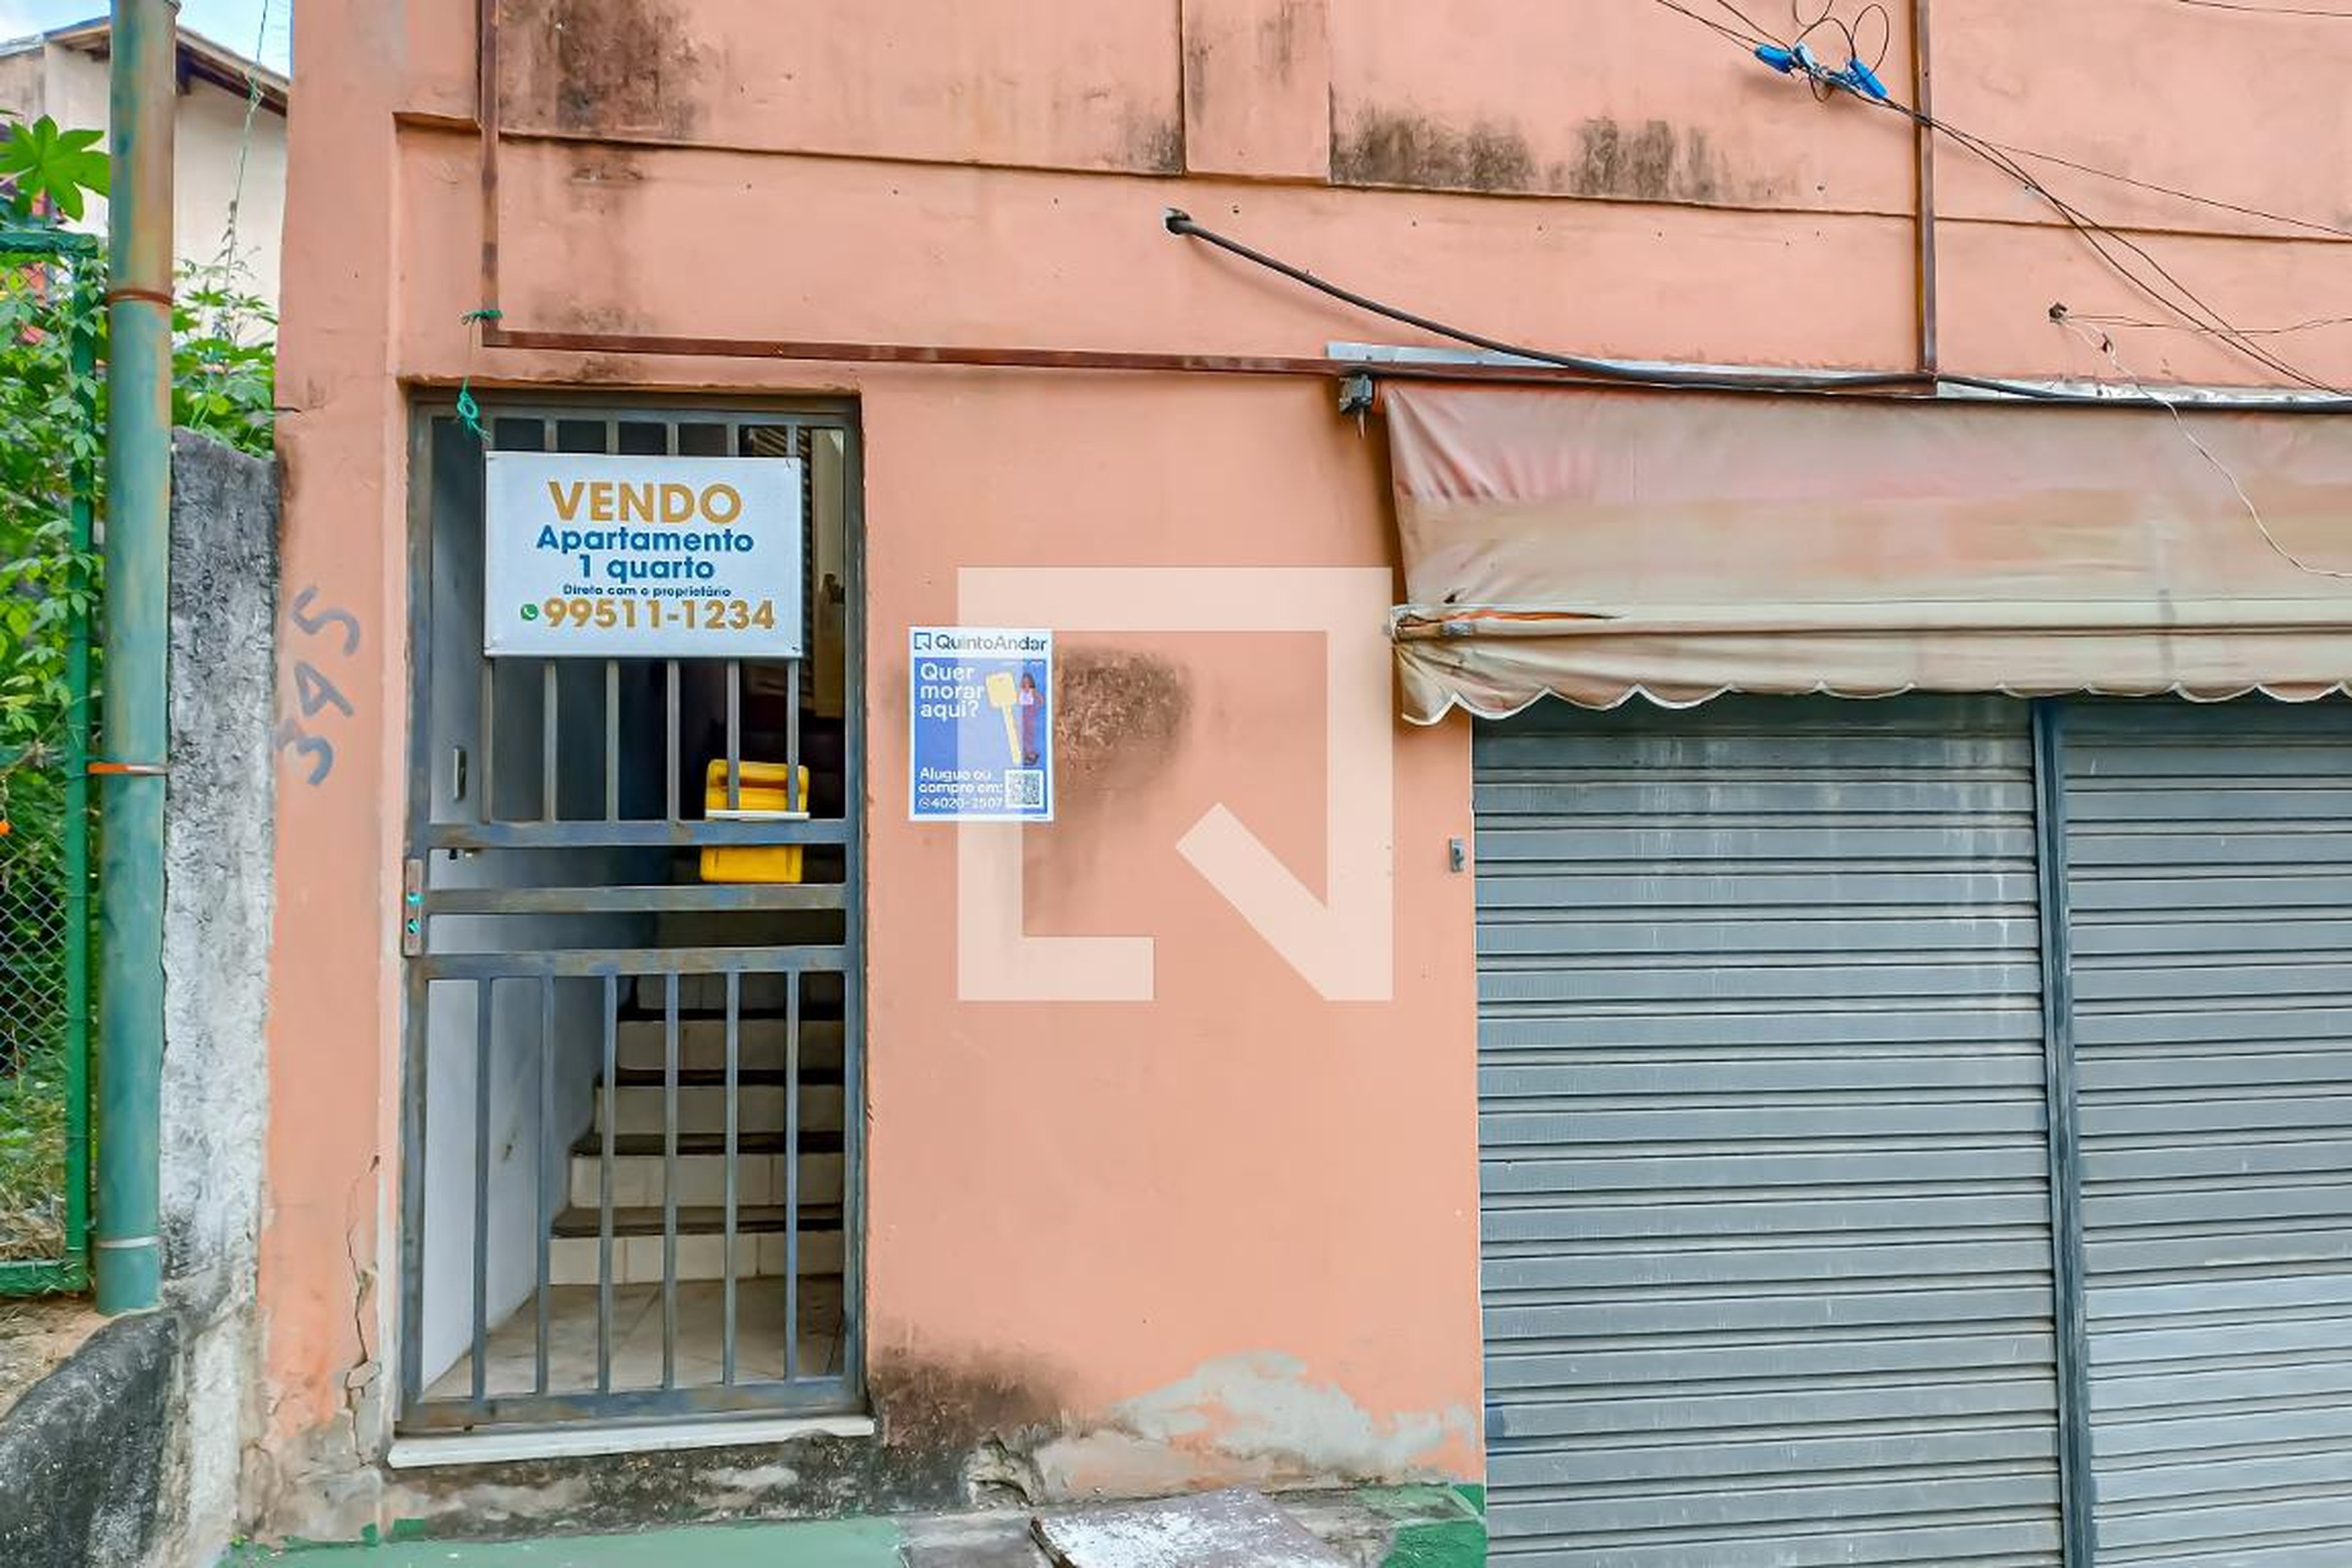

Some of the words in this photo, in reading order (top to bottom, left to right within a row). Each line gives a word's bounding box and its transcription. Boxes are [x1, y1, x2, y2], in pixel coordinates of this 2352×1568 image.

[548, 481, 742, 524] VENDO
[537, 526, 754, 554] Apartamento
[579, 554, 591, 578] 1
[607, 557, 715, 584] quarto
[563, 584, 603, 595] Direto
[607, 587, 637, 595] com
[653, 586, 732, 598] proprietário
[544, 598, 775, 630] 99511-1234
[920, 662, 975, 680] Quer
[920, 684, 984, 699] morar
[920, 701, 980, 722] aqui?
